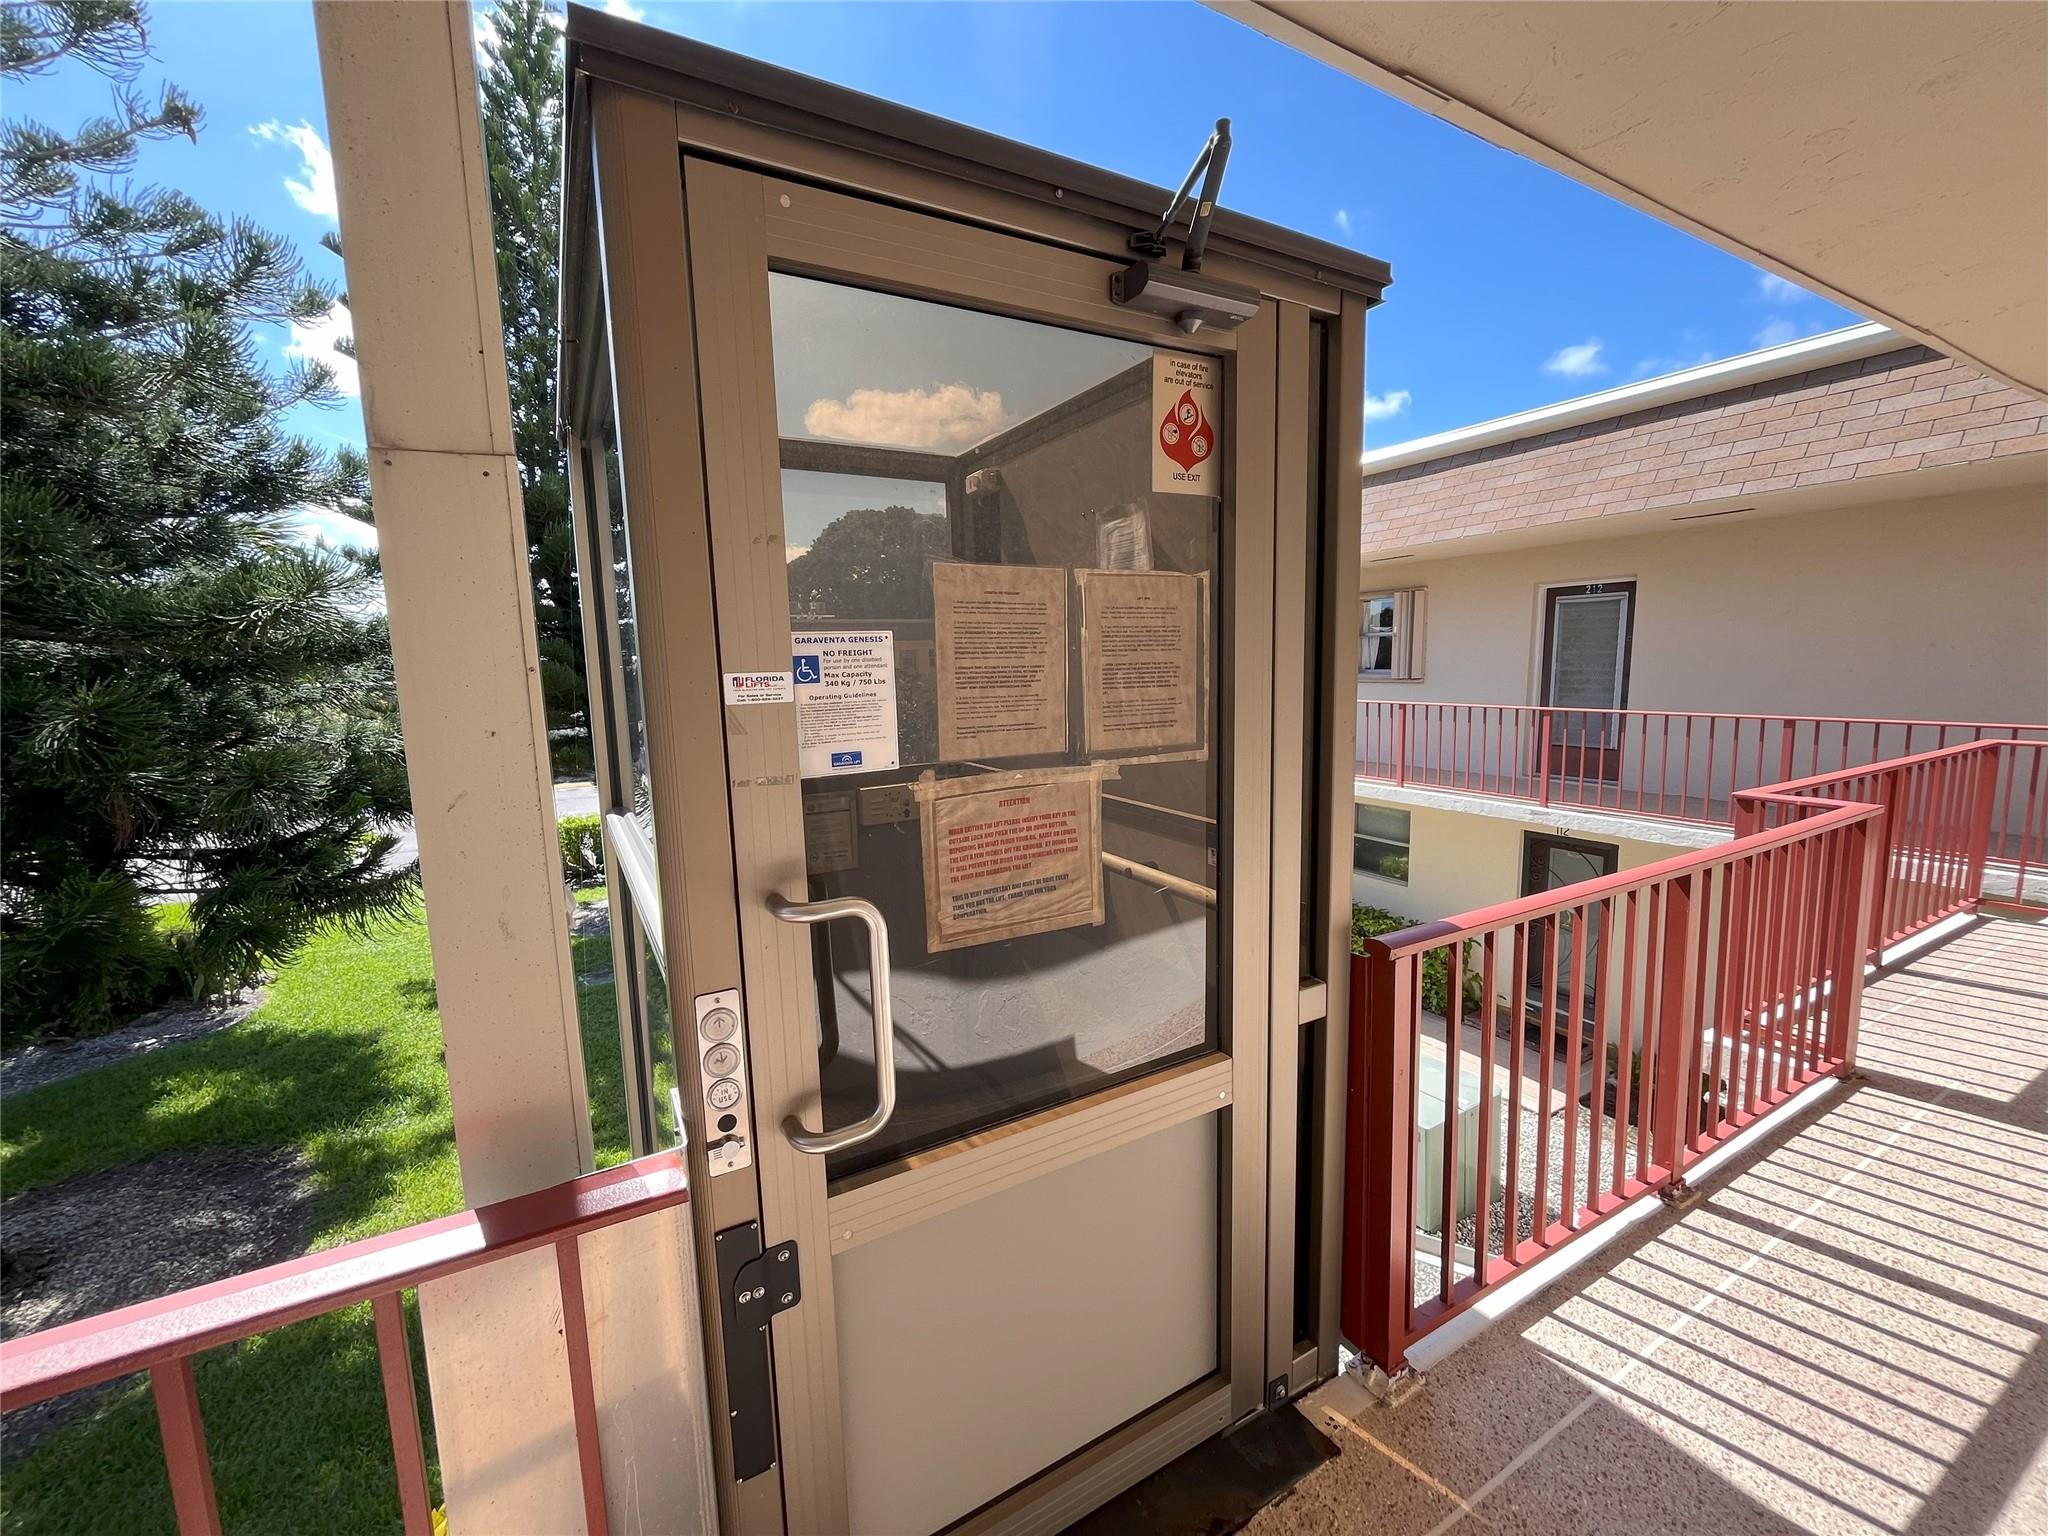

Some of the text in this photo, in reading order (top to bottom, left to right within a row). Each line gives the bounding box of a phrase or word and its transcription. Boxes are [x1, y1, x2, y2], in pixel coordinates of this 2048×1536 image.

[1199, 364, 1208, 372] fire
[1176, 369, 1202, 380] elevators
[1193, 381, 1214, 390] service
[1173, 472, 1186, 481] USE
[1585, 584, 1603, 594] 212
[999, 798, 1030, 807] ATTENTION
[968, 862, 989, 870] PREVENT
[719, 1095, 732, 1103] USE
